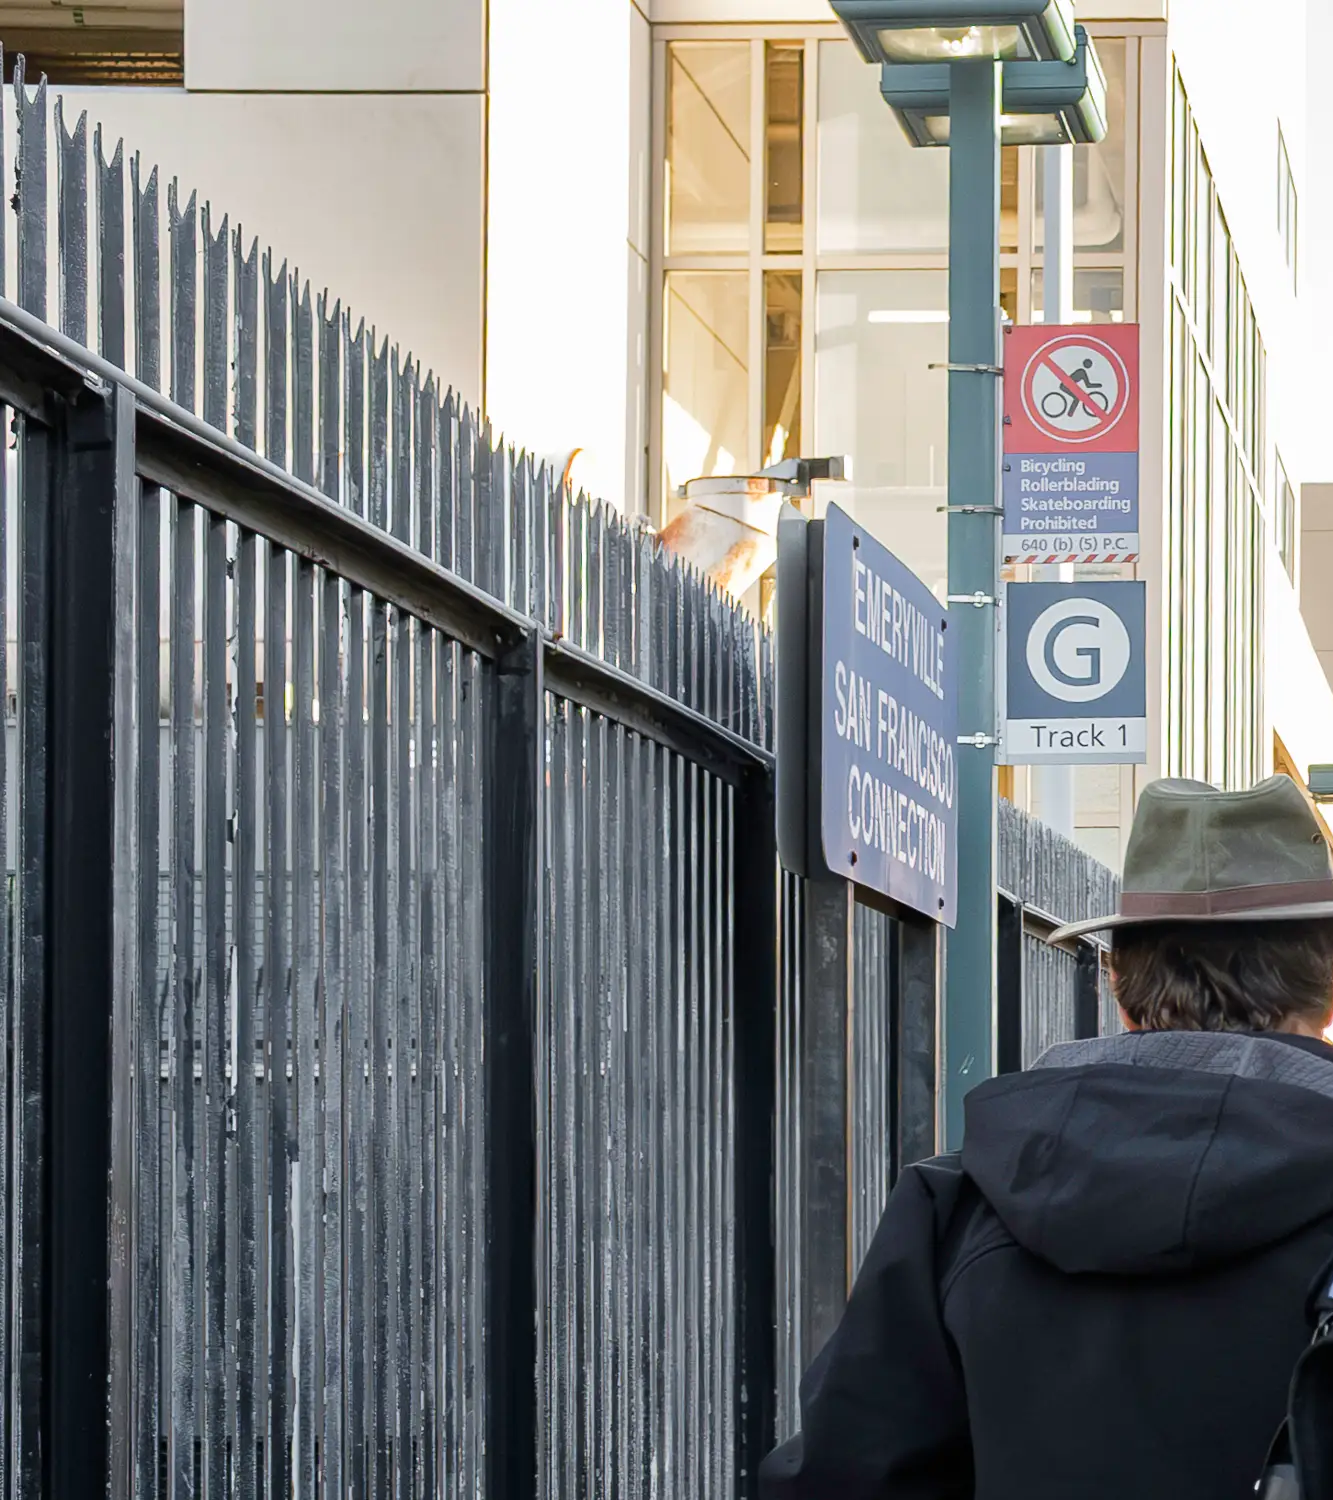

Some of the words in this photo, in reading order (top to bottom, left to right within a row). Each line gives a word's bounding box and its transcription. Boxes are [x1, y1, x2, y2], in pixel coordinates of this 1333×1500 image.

[1020, 458, 1086, 475] Bicycling
[1020, 477, 1120, 494] Rollerblading
[1020, 496, 1131, 513] Skateboarding
[1020, 515, 1097, 530] Prohibited
[1021, 538, 1048, 551] 640
[1053, 536, 1073, 552] (b)
[1079, 536, 1098, 552] (5)
[1103, 537, 1129, 550] P.C.
[854, 563, 944, 700] EMERYVILLE
[1043, 615, 1102, 687] G
[834, 659, 872, 751] SAN
[877, 689, 954, 809] FRANCISCO
[1031, 723, 1106, 749] Track
[1117, 723, 1128, 746] 1
[848, 763, 945, 886] CONNECTION
